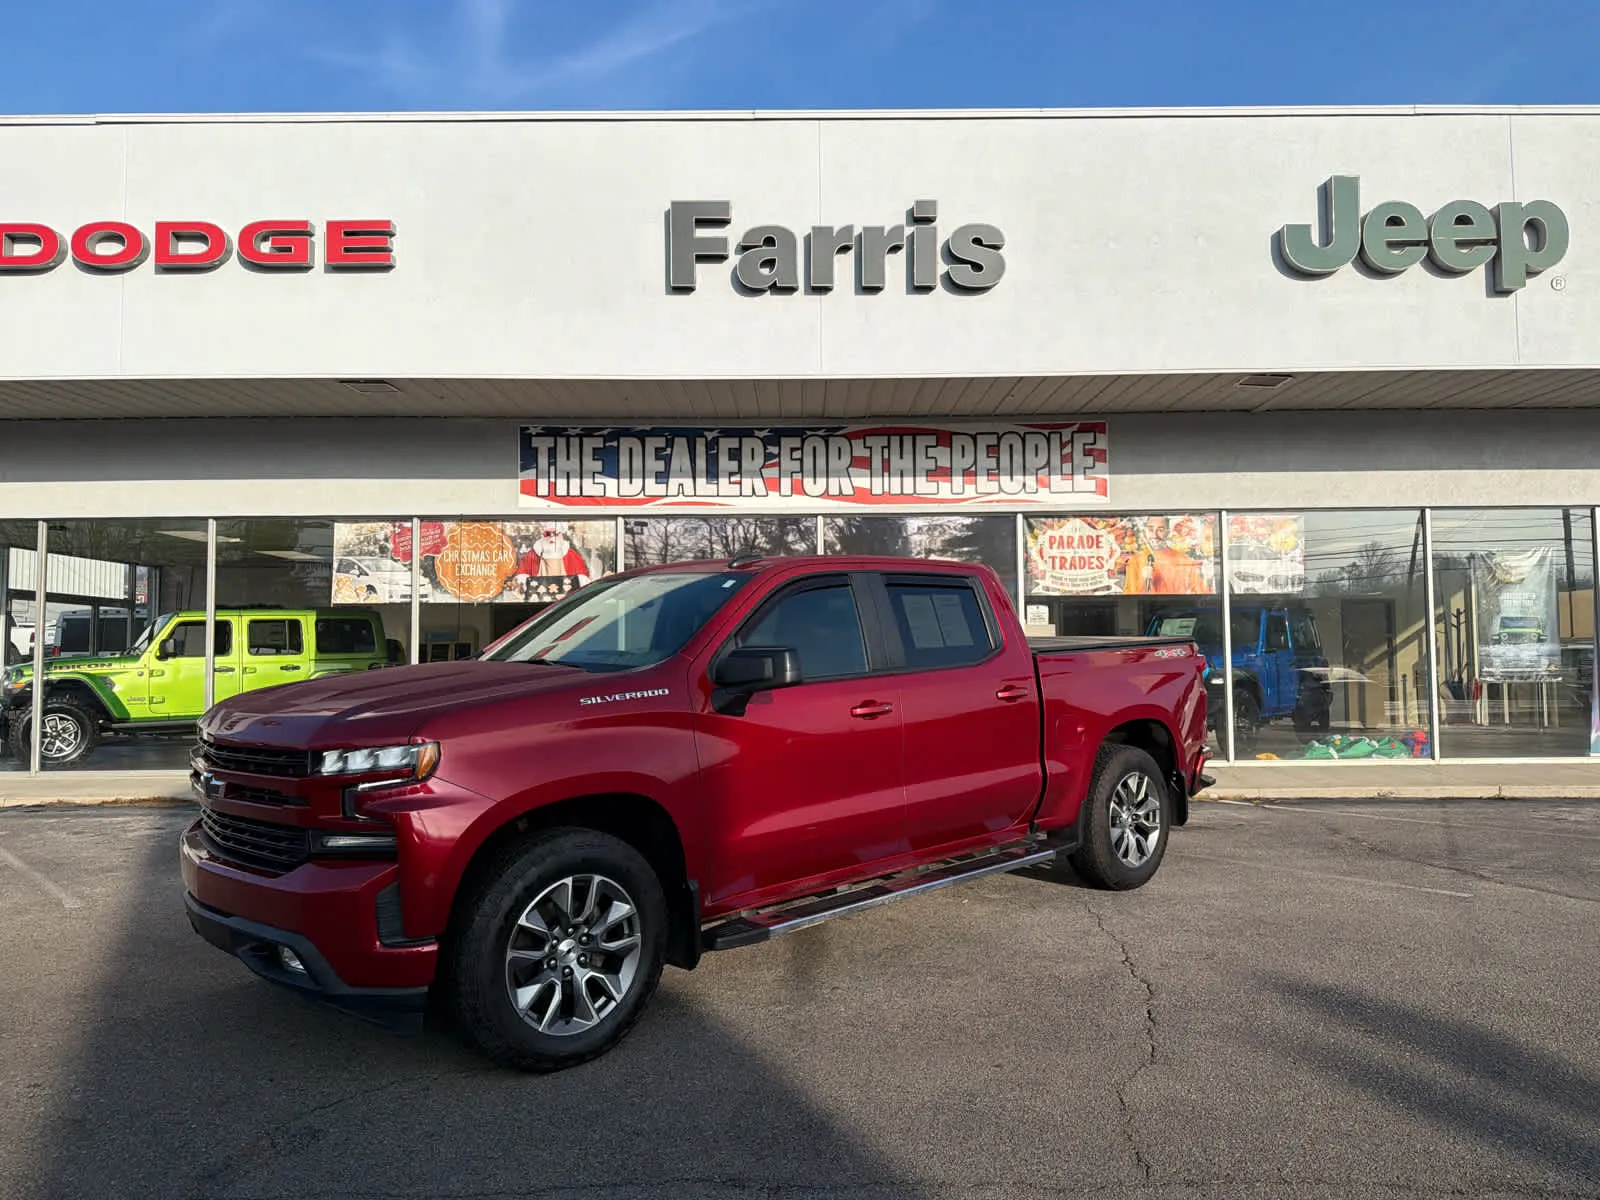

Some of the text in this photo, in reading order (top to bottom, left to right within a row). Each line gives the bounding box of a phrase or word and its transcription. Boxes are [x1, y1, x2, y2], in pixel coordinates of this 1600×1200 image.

[0, 219, 395, 271] DODGE
[665, 199, 1006, 294] Farris
[1274, 174, 1569, 295] Jeep
[531, 431, 1096, 498] THE DEALER FOR THE PEOPLE
[1048, 534, 1104, 549] PARADE
[455, 563, 497, 576] EXCHANGE
[1048, 555, 1105, 570] TRADES
[579, 688, 669, 705] SILVERADO
